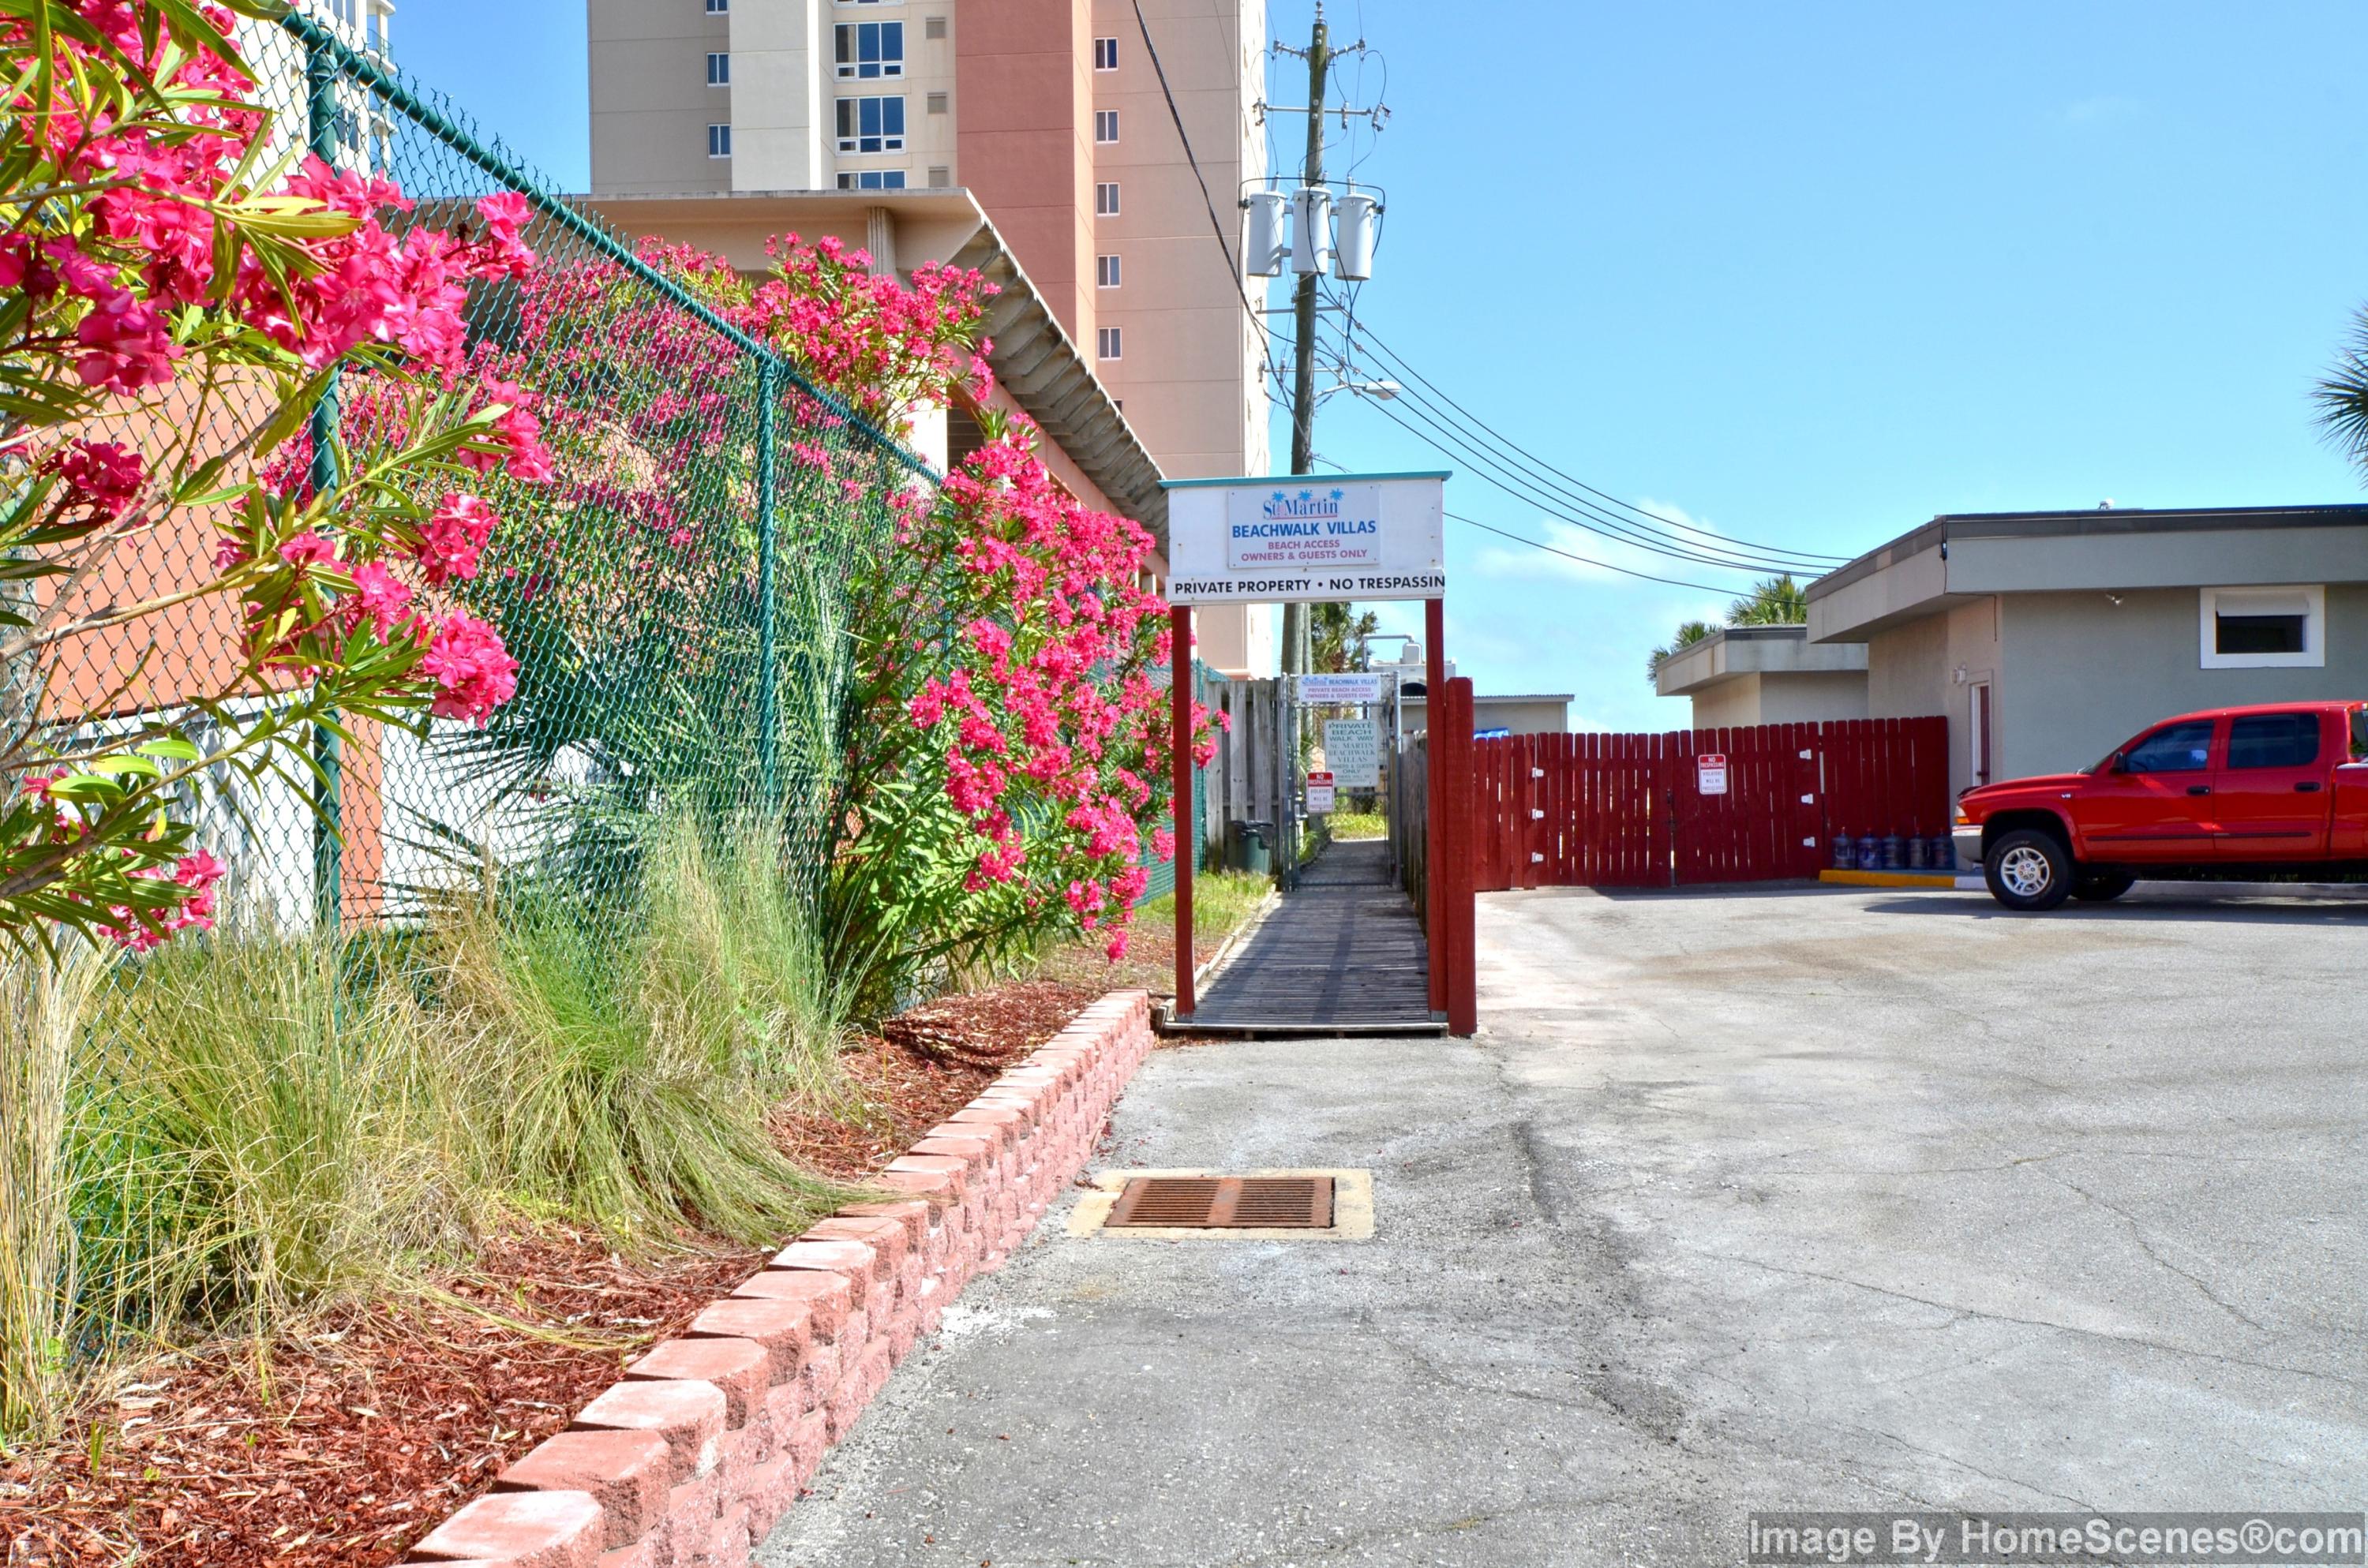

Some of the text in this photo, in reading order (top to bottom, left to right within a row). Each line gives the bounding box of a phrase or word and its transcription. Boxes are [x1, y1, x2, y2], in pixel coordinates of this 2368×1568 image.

[1284, 498, 1338, 515] Martin
[1232, 520, 1376, 538] BEACHWALK VILLAS
[1268, 539, 1340, 550] BEACH ACCESS
[1241, 549, 1368, 562] OWNERS & GUESTS ONLY
[1175, 582, 1233, 593] PRIVATE
[1238, 579, 1311, 593] PROPERTY
[1330, 578, 1353, 589] NO
